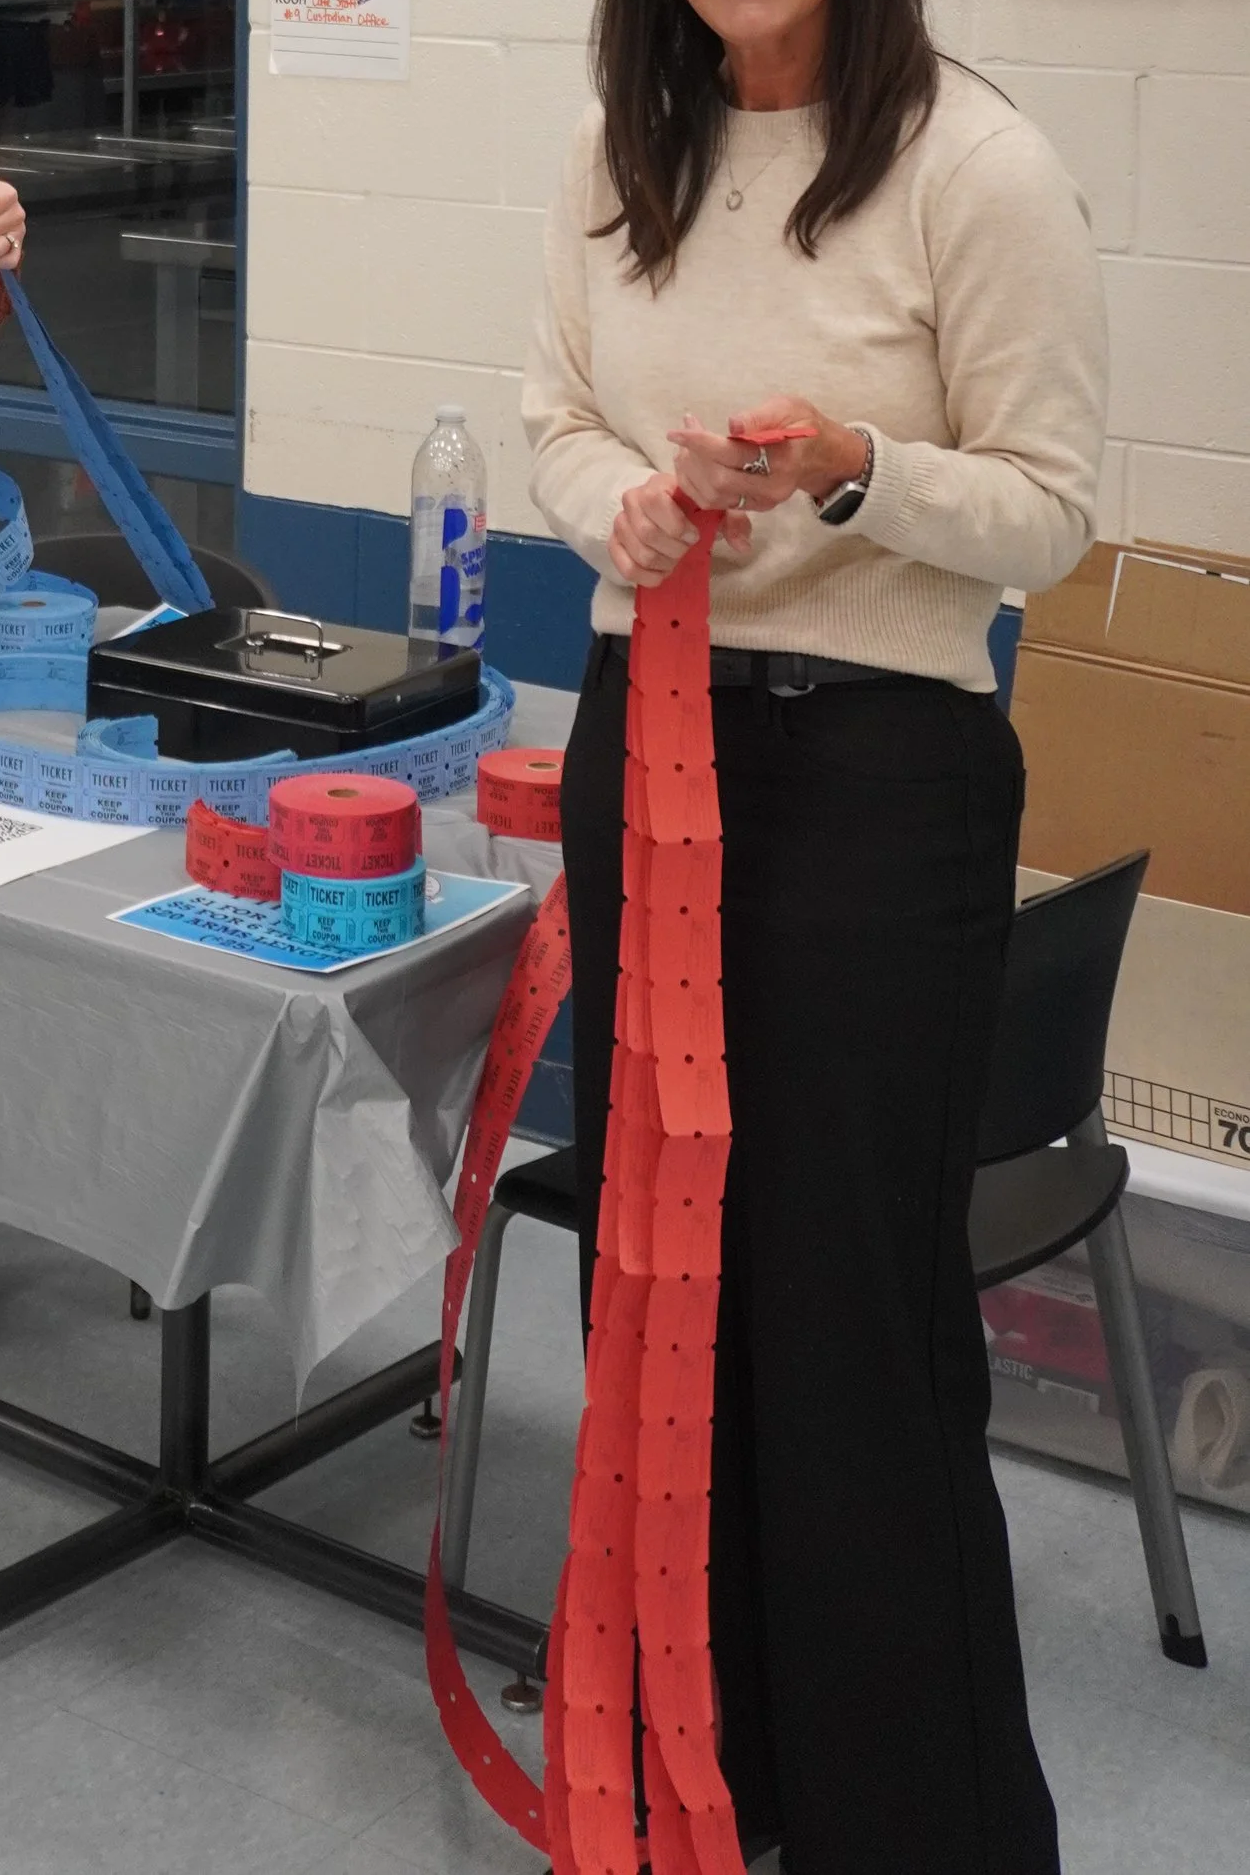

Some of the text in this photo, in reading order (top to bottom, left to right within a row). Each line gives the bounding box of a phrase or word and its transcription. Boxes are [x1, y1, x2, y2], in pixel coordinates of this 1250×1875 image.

[358, 12, 390, 28] Office
[44, 623, 75, 636] TICKET
[451, 739, 472, 757] TICKET
[414, 750, 439, 767] TICKET
[41, 764, 73, 781] TICKET
[371, 760, 400, 776] TICKET
[0, 779, 19, 790] KEEP
[92, 773, 129, 790] TICKET
[150, 778, 187, 793] TICKET
[209, 778, 247, 793] TICKET
[45, 789, 68, 799] KEEP
[418, 786, 440, 798] OUPON
[39, 801, 74, 814] COUPON
[97, 799, 122, 808] KEEP
[155, 804, 181, 812] KEEP
[214, 804, 240, 812] KEEP
[91, 811, 129, 822] COUPON
[148, 815, 188, 825] COUPON
[235, 843, 266, 861] TICKE
[310, 886, 345, 906] TICKET
[365, 889, 400, 906] TICKET
[144, 906, 184, 921] $20
[195, 908, 244, 925] FOR
[217, 904, 267, 922] FOR
[317, 916, 336, 926] KEEP
[373, 918, 392, 927] KEEP
[312, 930, 341, 943] COUPON
[368, 932, 396, 944] COUPON
[1214, 1106, 1250, 1124] ECONO
